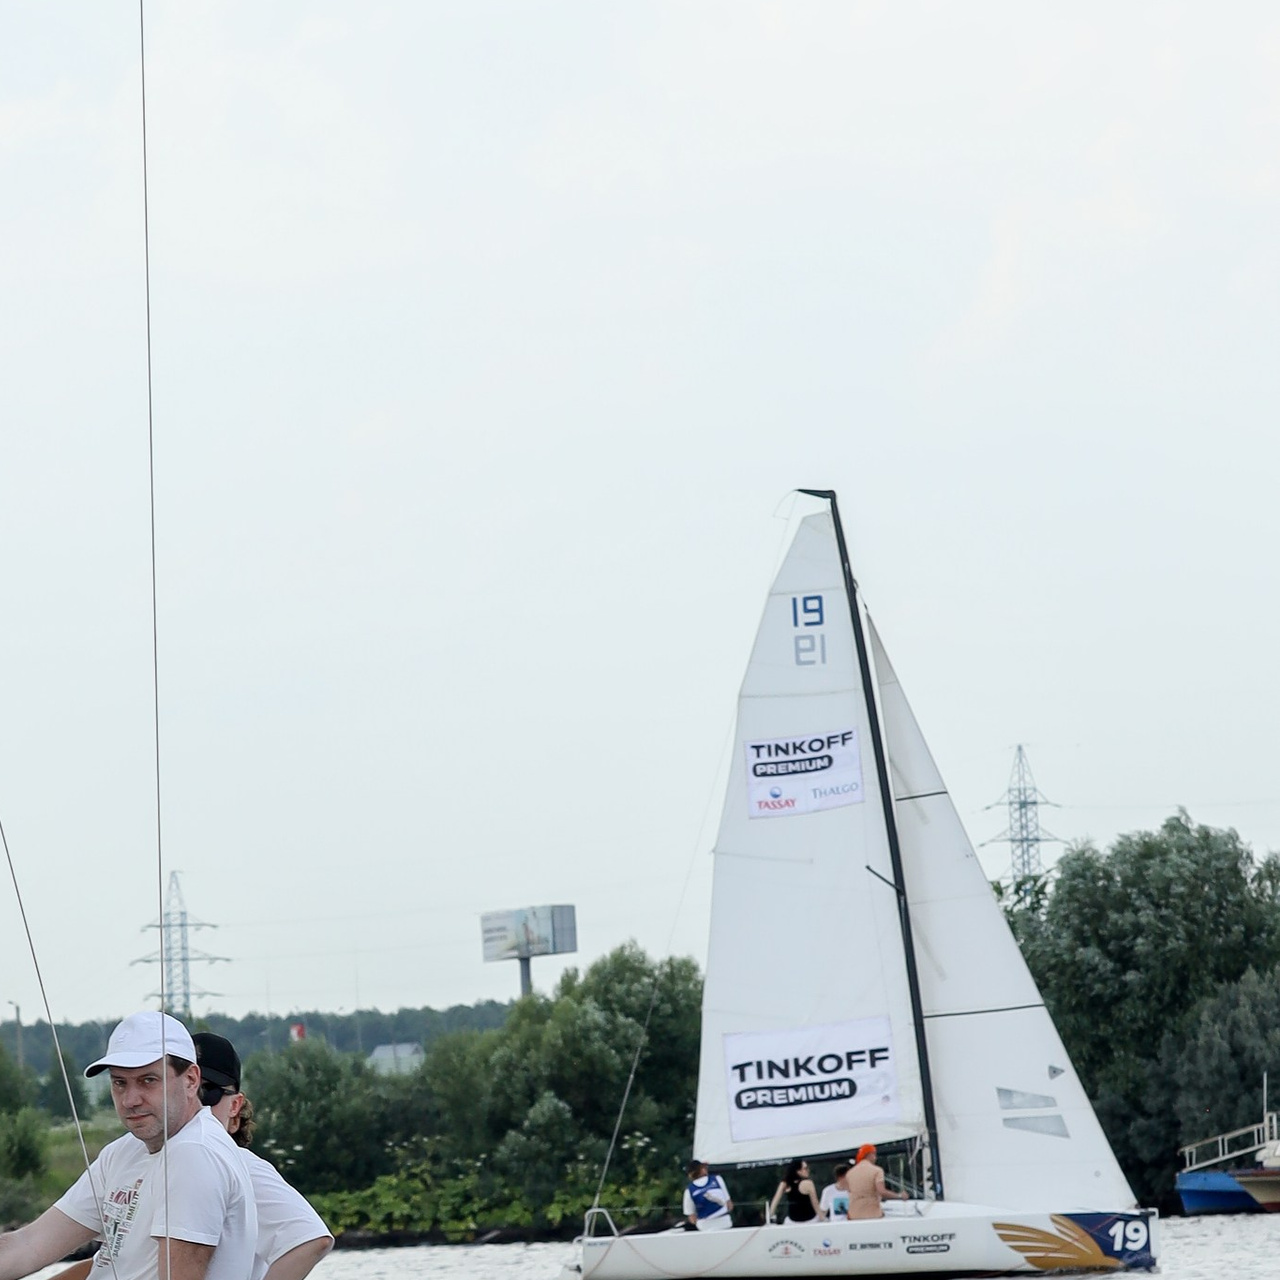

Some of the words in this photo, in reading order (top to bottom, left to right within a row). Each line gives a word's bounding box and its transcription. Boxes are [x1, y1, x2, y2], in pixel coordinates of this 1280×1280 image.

[792, 595, 824, 627] 19
[751, 731, 853, 759] TINKOFF
[756, 757, 829, 776] PREMIUM
[757, 798, 796, 811] TASSAY
[812, 782, 859, 800] THALGO
[731, 1047, 889, 1083] TINKOFF
[741, 1080, 850, 1108] PREMIUM
[900, 1233, 956, 1244] TINKOFF
[1108, 1220, 1148, 1252] 19
